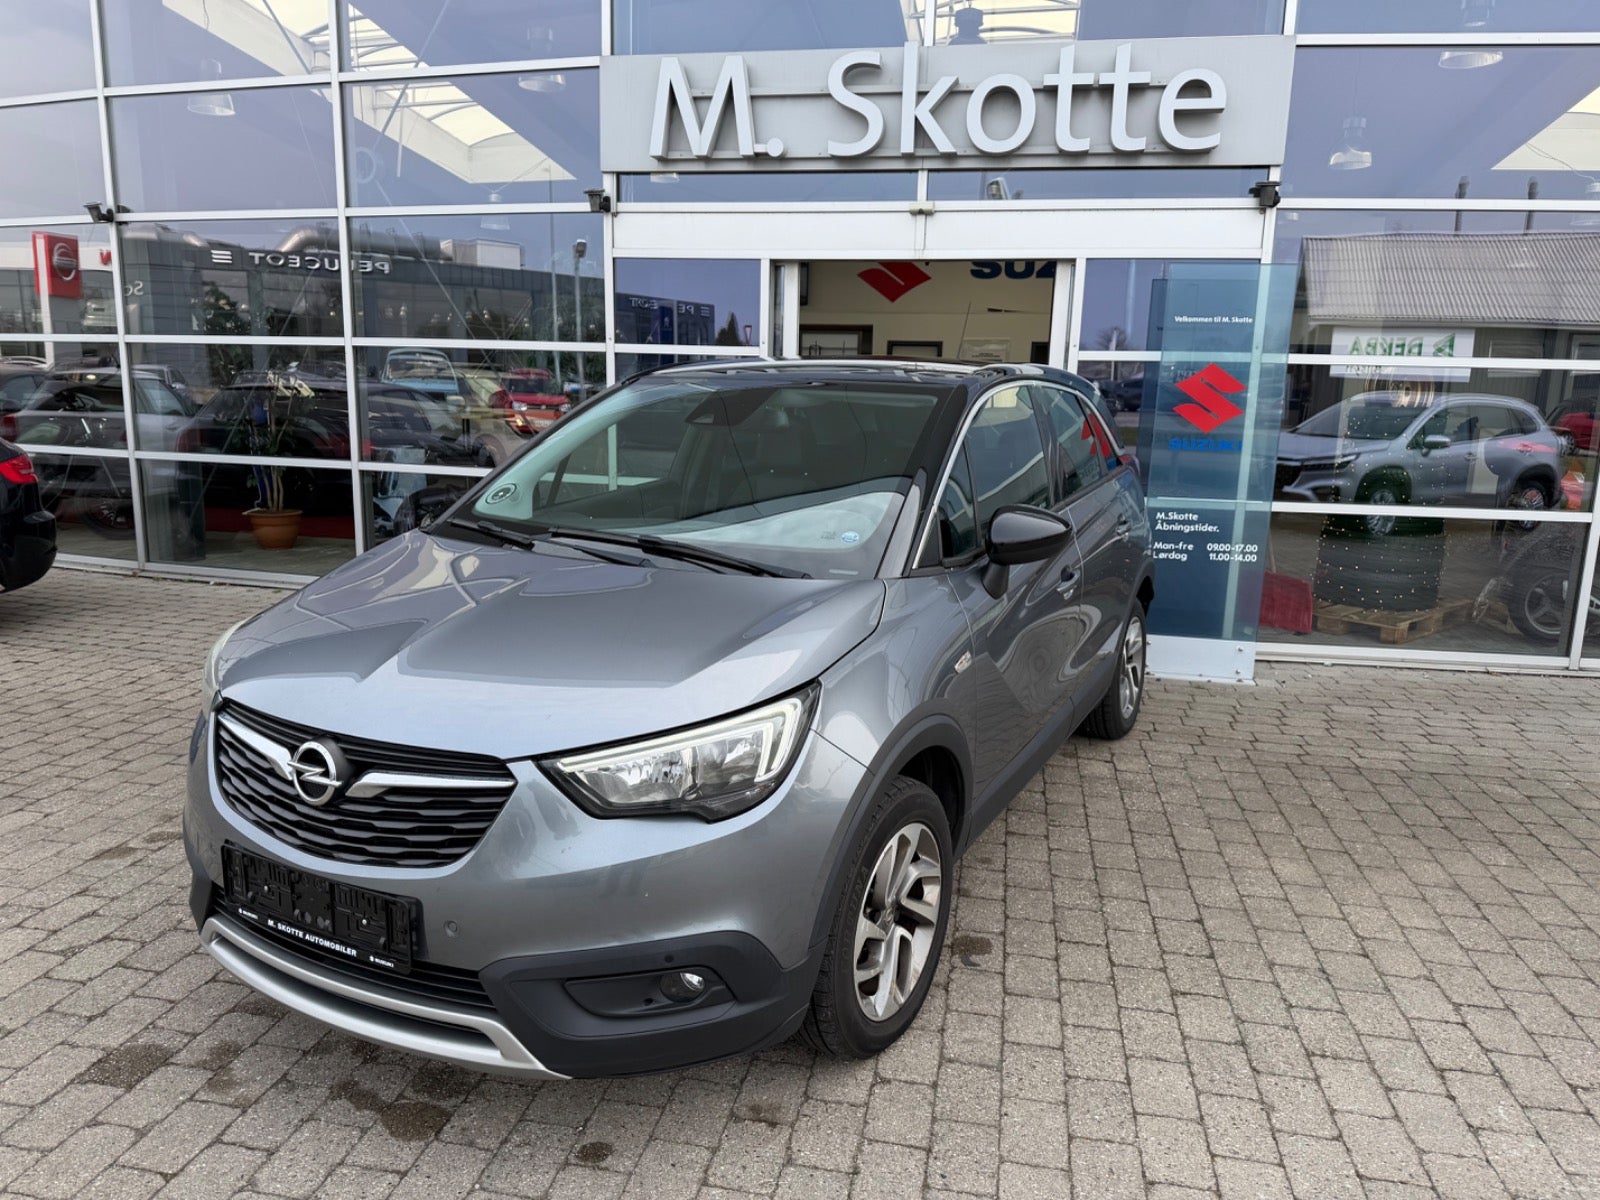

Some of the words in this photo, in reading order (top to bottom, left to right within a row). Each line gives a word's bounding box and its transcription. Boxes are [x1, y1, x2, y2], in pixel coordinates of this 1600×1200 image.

[650, 54, 785, 160] M.
[827, 40, 1228, 158] Skotte
[1174, 315, 1213, 323] Velkommen
[1213, 315, 1222, 323] til
[1231, 316, 1253, 324] Skotte
[1168, 437, 1244, 452] SUZUKI
[1154, 519, 1220, 533] Åbningstider.
[1153, 541, 1195, 551] Man-fre
[1152, 550, 1188, 562] Lørdag
[267, 918, 276, 928] M.
[276, 923, 304, 938] SKOTTE
[304, 934, 358, 957] AUTOMOBILER
